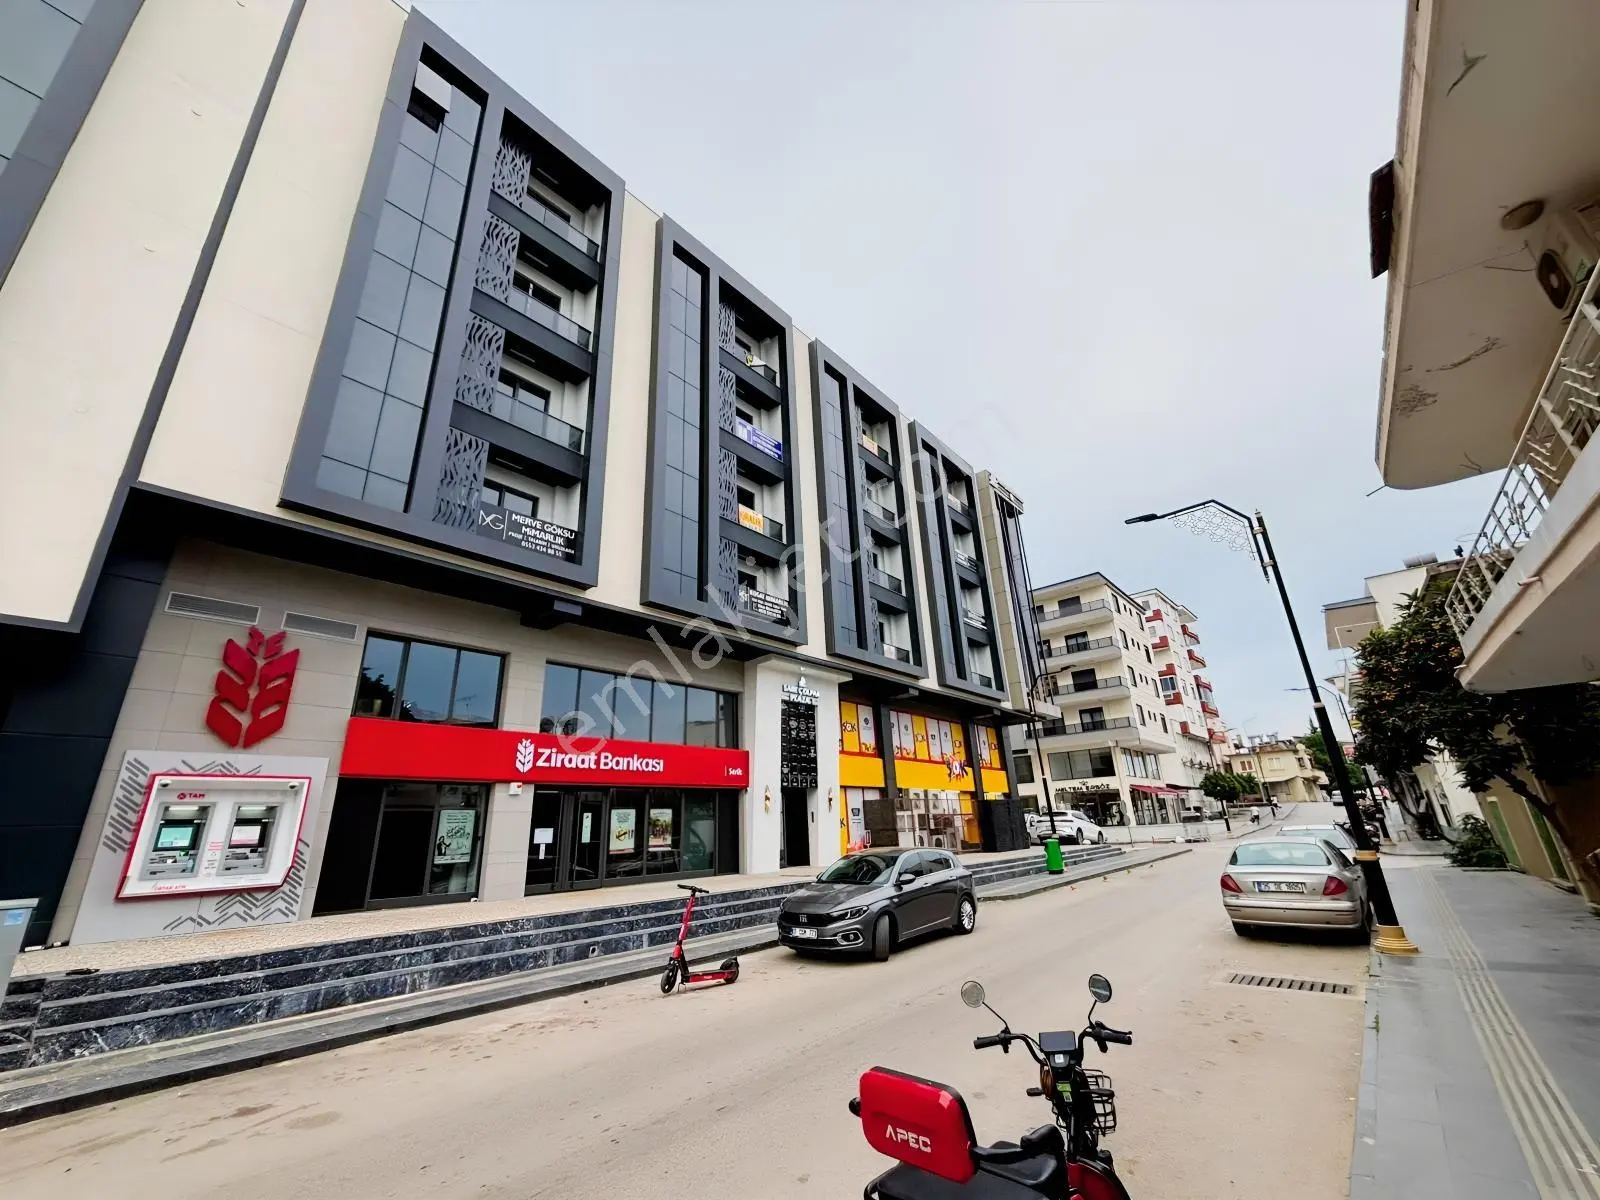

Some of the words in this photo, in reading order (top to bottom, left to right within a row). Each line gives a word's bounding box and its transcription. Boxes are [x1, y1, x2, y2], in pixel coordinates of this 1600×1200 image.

[512, 513, 542, 530] MERVE
[544, 522, 575, 539] GÖKSU
[536, 748, 597, 769] Ziraat
[600, 752, 664, 772] Bankası
[885, 1124, 932, 1153] APEC
